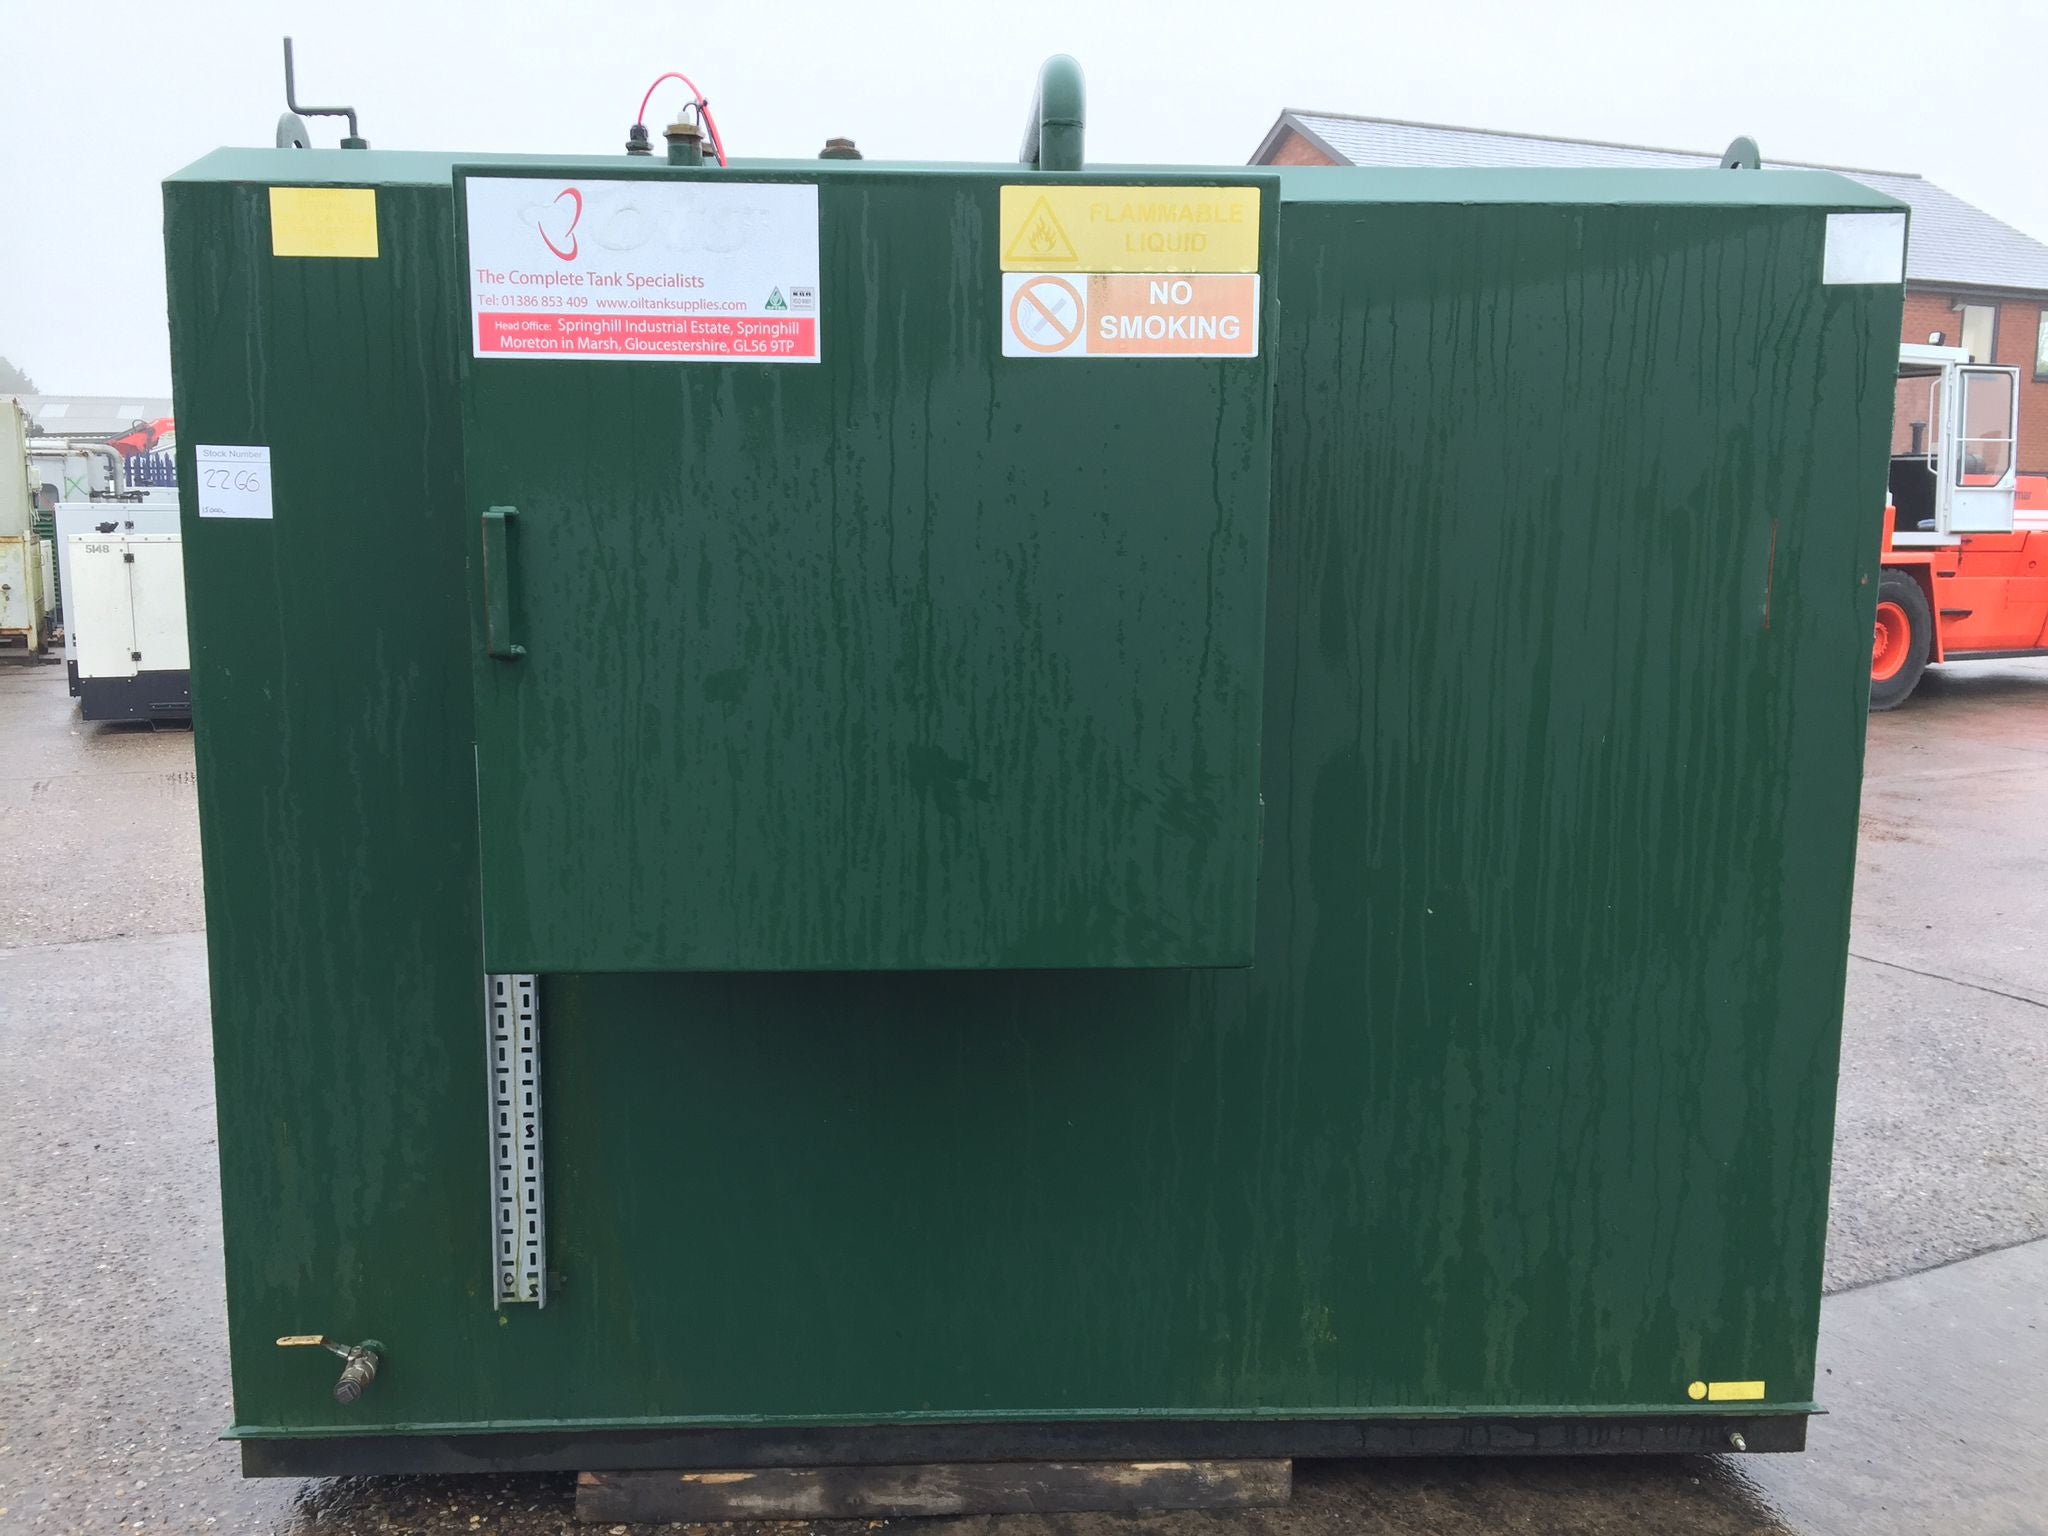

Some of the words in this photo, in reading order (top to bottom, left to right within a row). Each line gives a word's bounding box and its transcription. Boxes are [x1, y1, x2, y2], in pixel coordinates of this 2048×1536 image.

[1090, 203, 1244, 224] FLAMMABLE
[1125, 232, 1209, 253] LIQUID
[476, 269, 505, 284] The
[509, 270, 584, 289] Complete
[587, 271, 622, 287] Tank
[627, 272, 705, 290] Specialists
[478, 294, 499, 306] Tel:
[502, 295, 539, 307] 01386
[541, 296, 563, 307] 853
[566, 296, 588, 308] 409
[596, 296, 747, 312] www.oiltanksupplies.com
[1150, 280, 1193, 305] NO
[495, 320, 519, 331] Head
[522, 321, 552, 332] Office:
[557, 318, 622, 336] Springhill
[625, 318, 687, 334] Industrial
[690, 321, 734, 336] Estate,
[737, 321, 800, 338] Springhill
[1100, 315, 1240, 340] SMOKING
[500, 335, 558, 349] Moreton
[561, 336, 574, 349] in
[577, 336, 622, 352] Marsh,
[624, 336, 731, 353] Gloucestershire,
[733, 339, 768, 352] GL56
[770, 340, 795, 353] 9TP
[203, 449, 227, 458] Stock
[229, 450, 262, 459] Number
